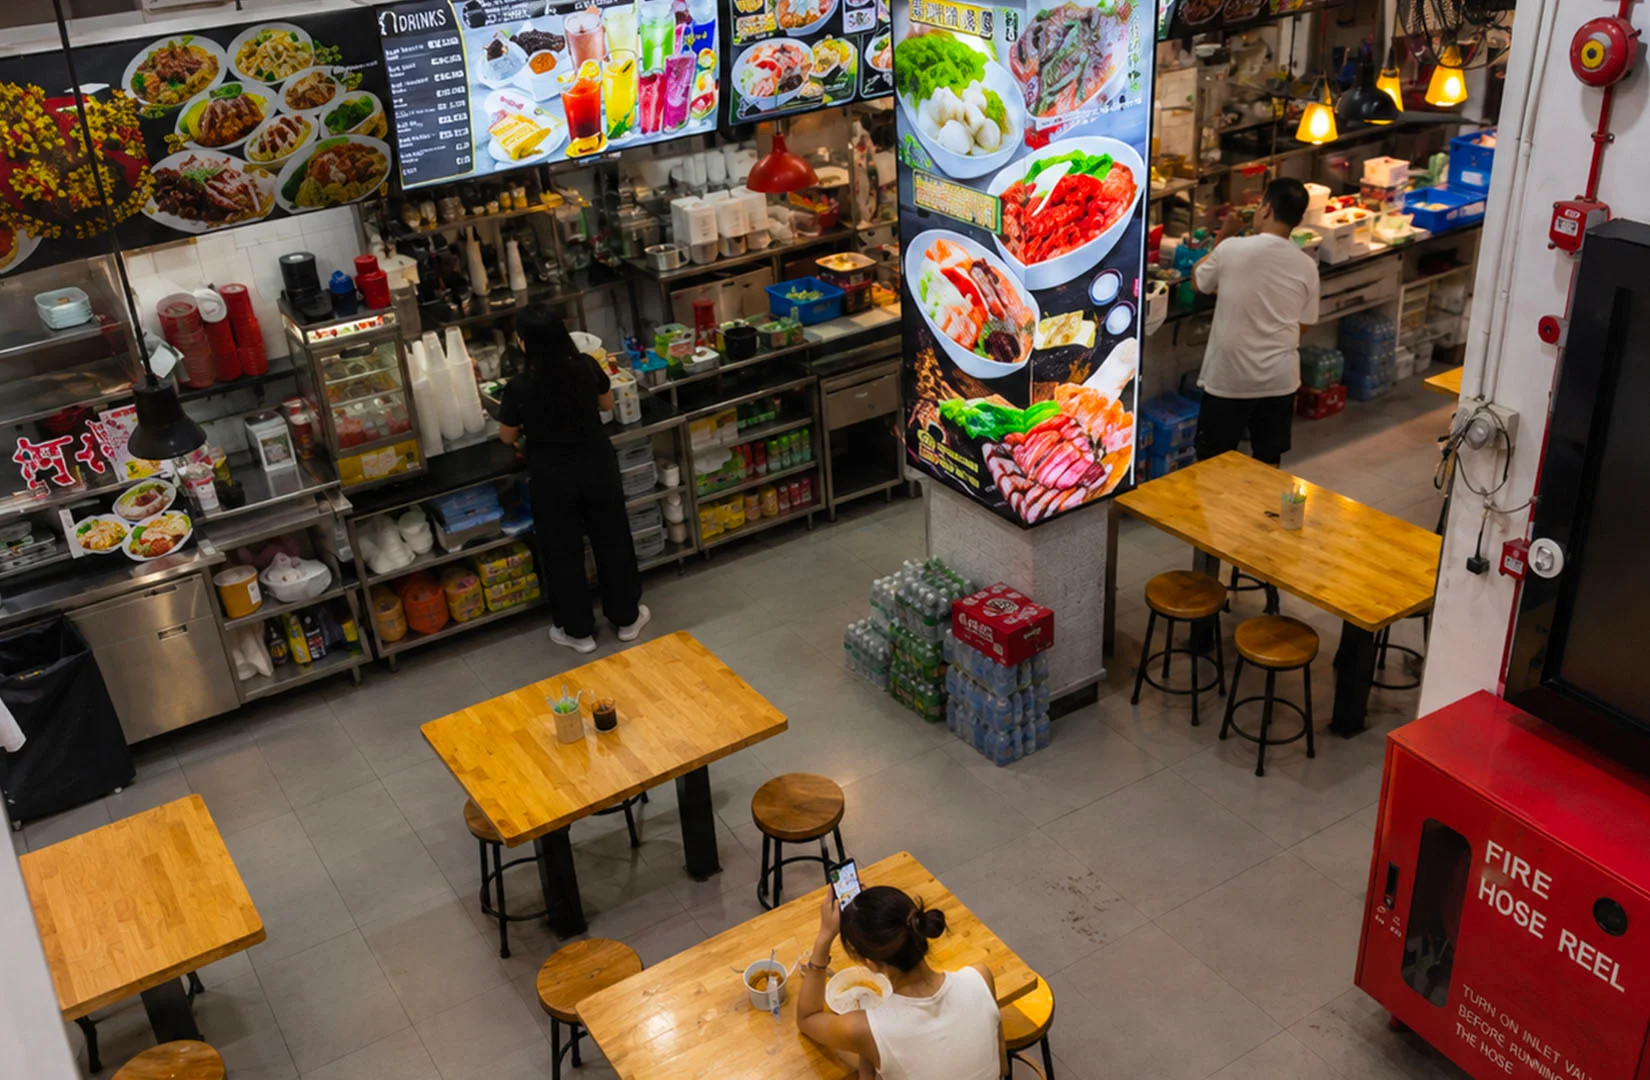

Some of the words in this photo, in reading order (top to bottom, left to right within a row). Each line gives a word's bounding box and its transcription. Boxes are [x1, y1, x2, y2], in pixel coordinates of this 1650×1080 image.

[399, 9, 446, 31] DRINKS
[1485, 840, 1552, 899] FIRE
[1478, 876, 1547, 939] HOSE
[1557, 928, 1625, 993] REEL
[1455, 1022, 1477, 1048] THE
[1479, 1041, 1514, 1075] HOSE
[1458, 1004, 1505, 1048] BEFORE
[1462, 984, 1496, 1017] TURN
[1500, 1013, 1519, 1034] ON
[1522, 1030, 1561, 1064] INLET
[1565, 1060, 1592, 1080] VAL
